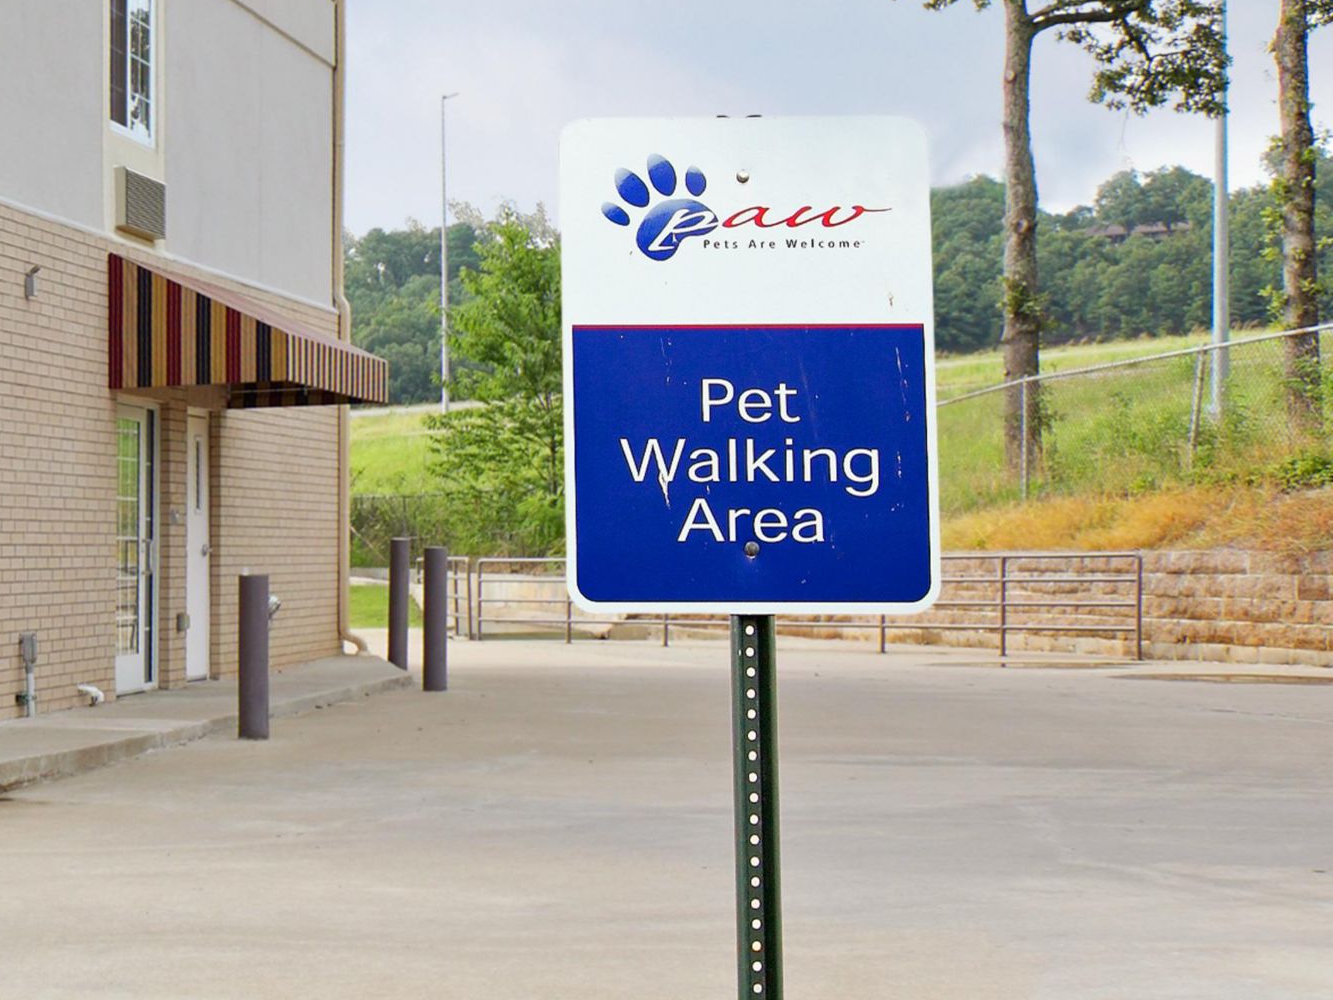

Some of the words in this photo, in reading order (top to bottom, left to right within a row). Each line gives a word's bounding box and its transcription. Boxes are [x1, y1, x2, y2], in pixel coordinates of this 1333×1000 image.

[647, 205, 893, 252] paw
[702, 238, 739, 250] Pets
[747, 238, 777, 250] Are
[785, 238, 862, 250] Welcome
[700, 377, 801, 424] Pet
[619, 437, 881, 498] Walking
[676, 497, 826, 544] Area
